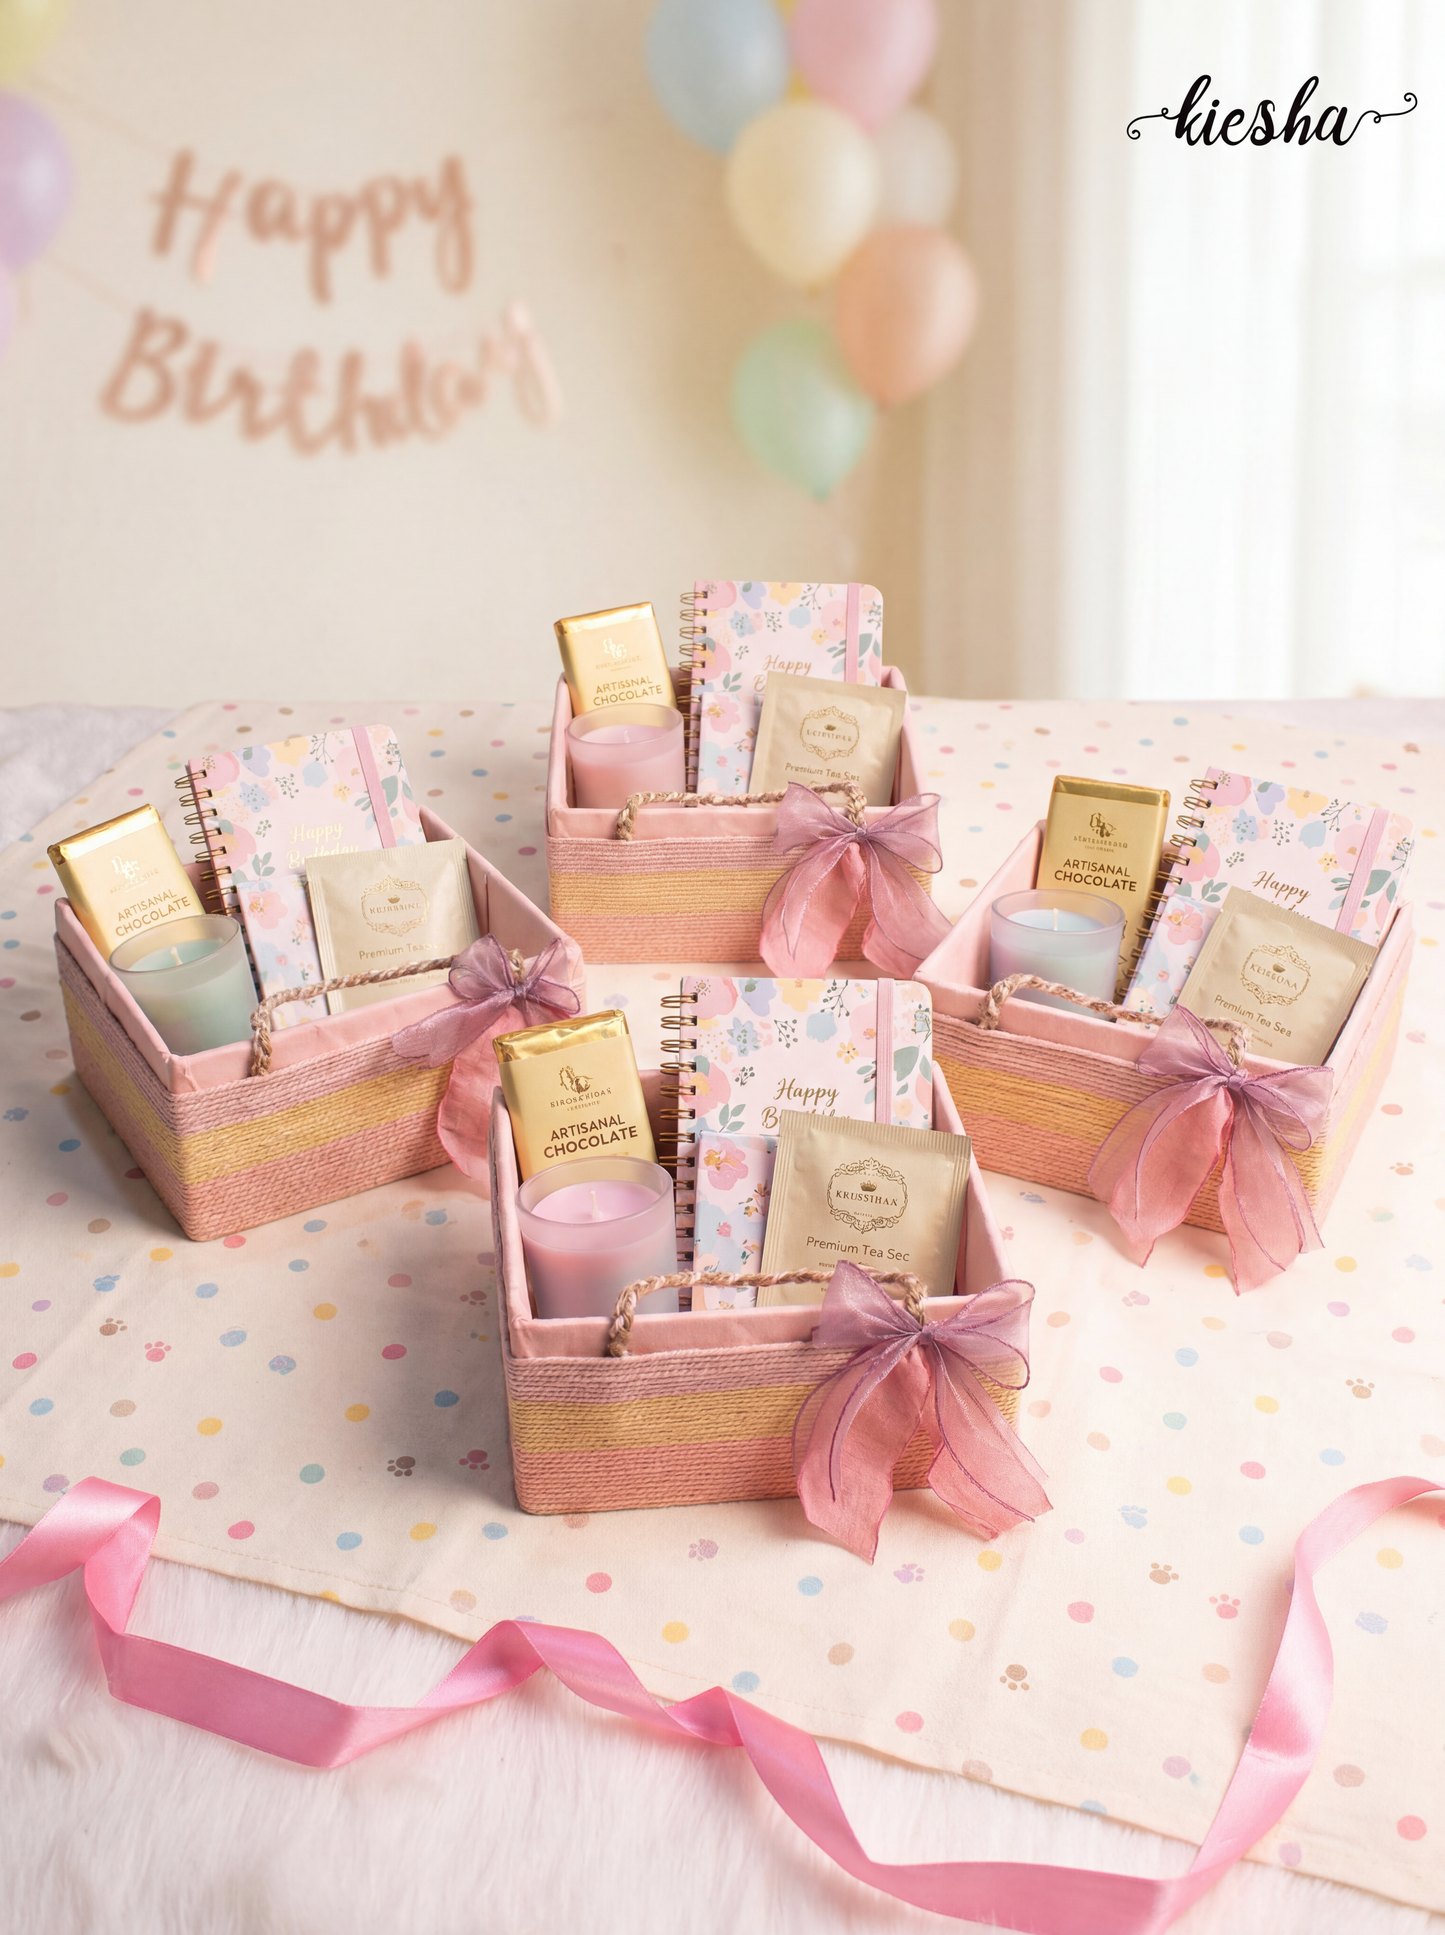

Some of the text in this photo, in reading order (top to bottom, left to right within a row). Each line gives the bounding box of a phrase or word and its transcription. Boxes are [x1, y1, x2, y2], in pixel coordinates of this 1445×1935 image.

[150, 148, 477, 306] Happy
[762, 654, 812, 677] Happy
[593, 684, 663, 706] CHOCOLATE
[286, 822, 344, 844] Happy
[1054, 870, 1137, 892] CHOCOLATE
[1063, 858, 1131, 877] ARTISANAL
[1252, 871, 1312, 904] Happy
[115, 896, 191, 937] CHOCOLATE
[117, 889, 177, 922] ARTISANAL
[773, 1078, 840, 1107] Happy
[550, 1114, 625, 1141] ARTISANAL
[543, 1125, 638, 1158] CHOCOLATE
[806, 1236, 910, 1262] Premium Tea Sec
